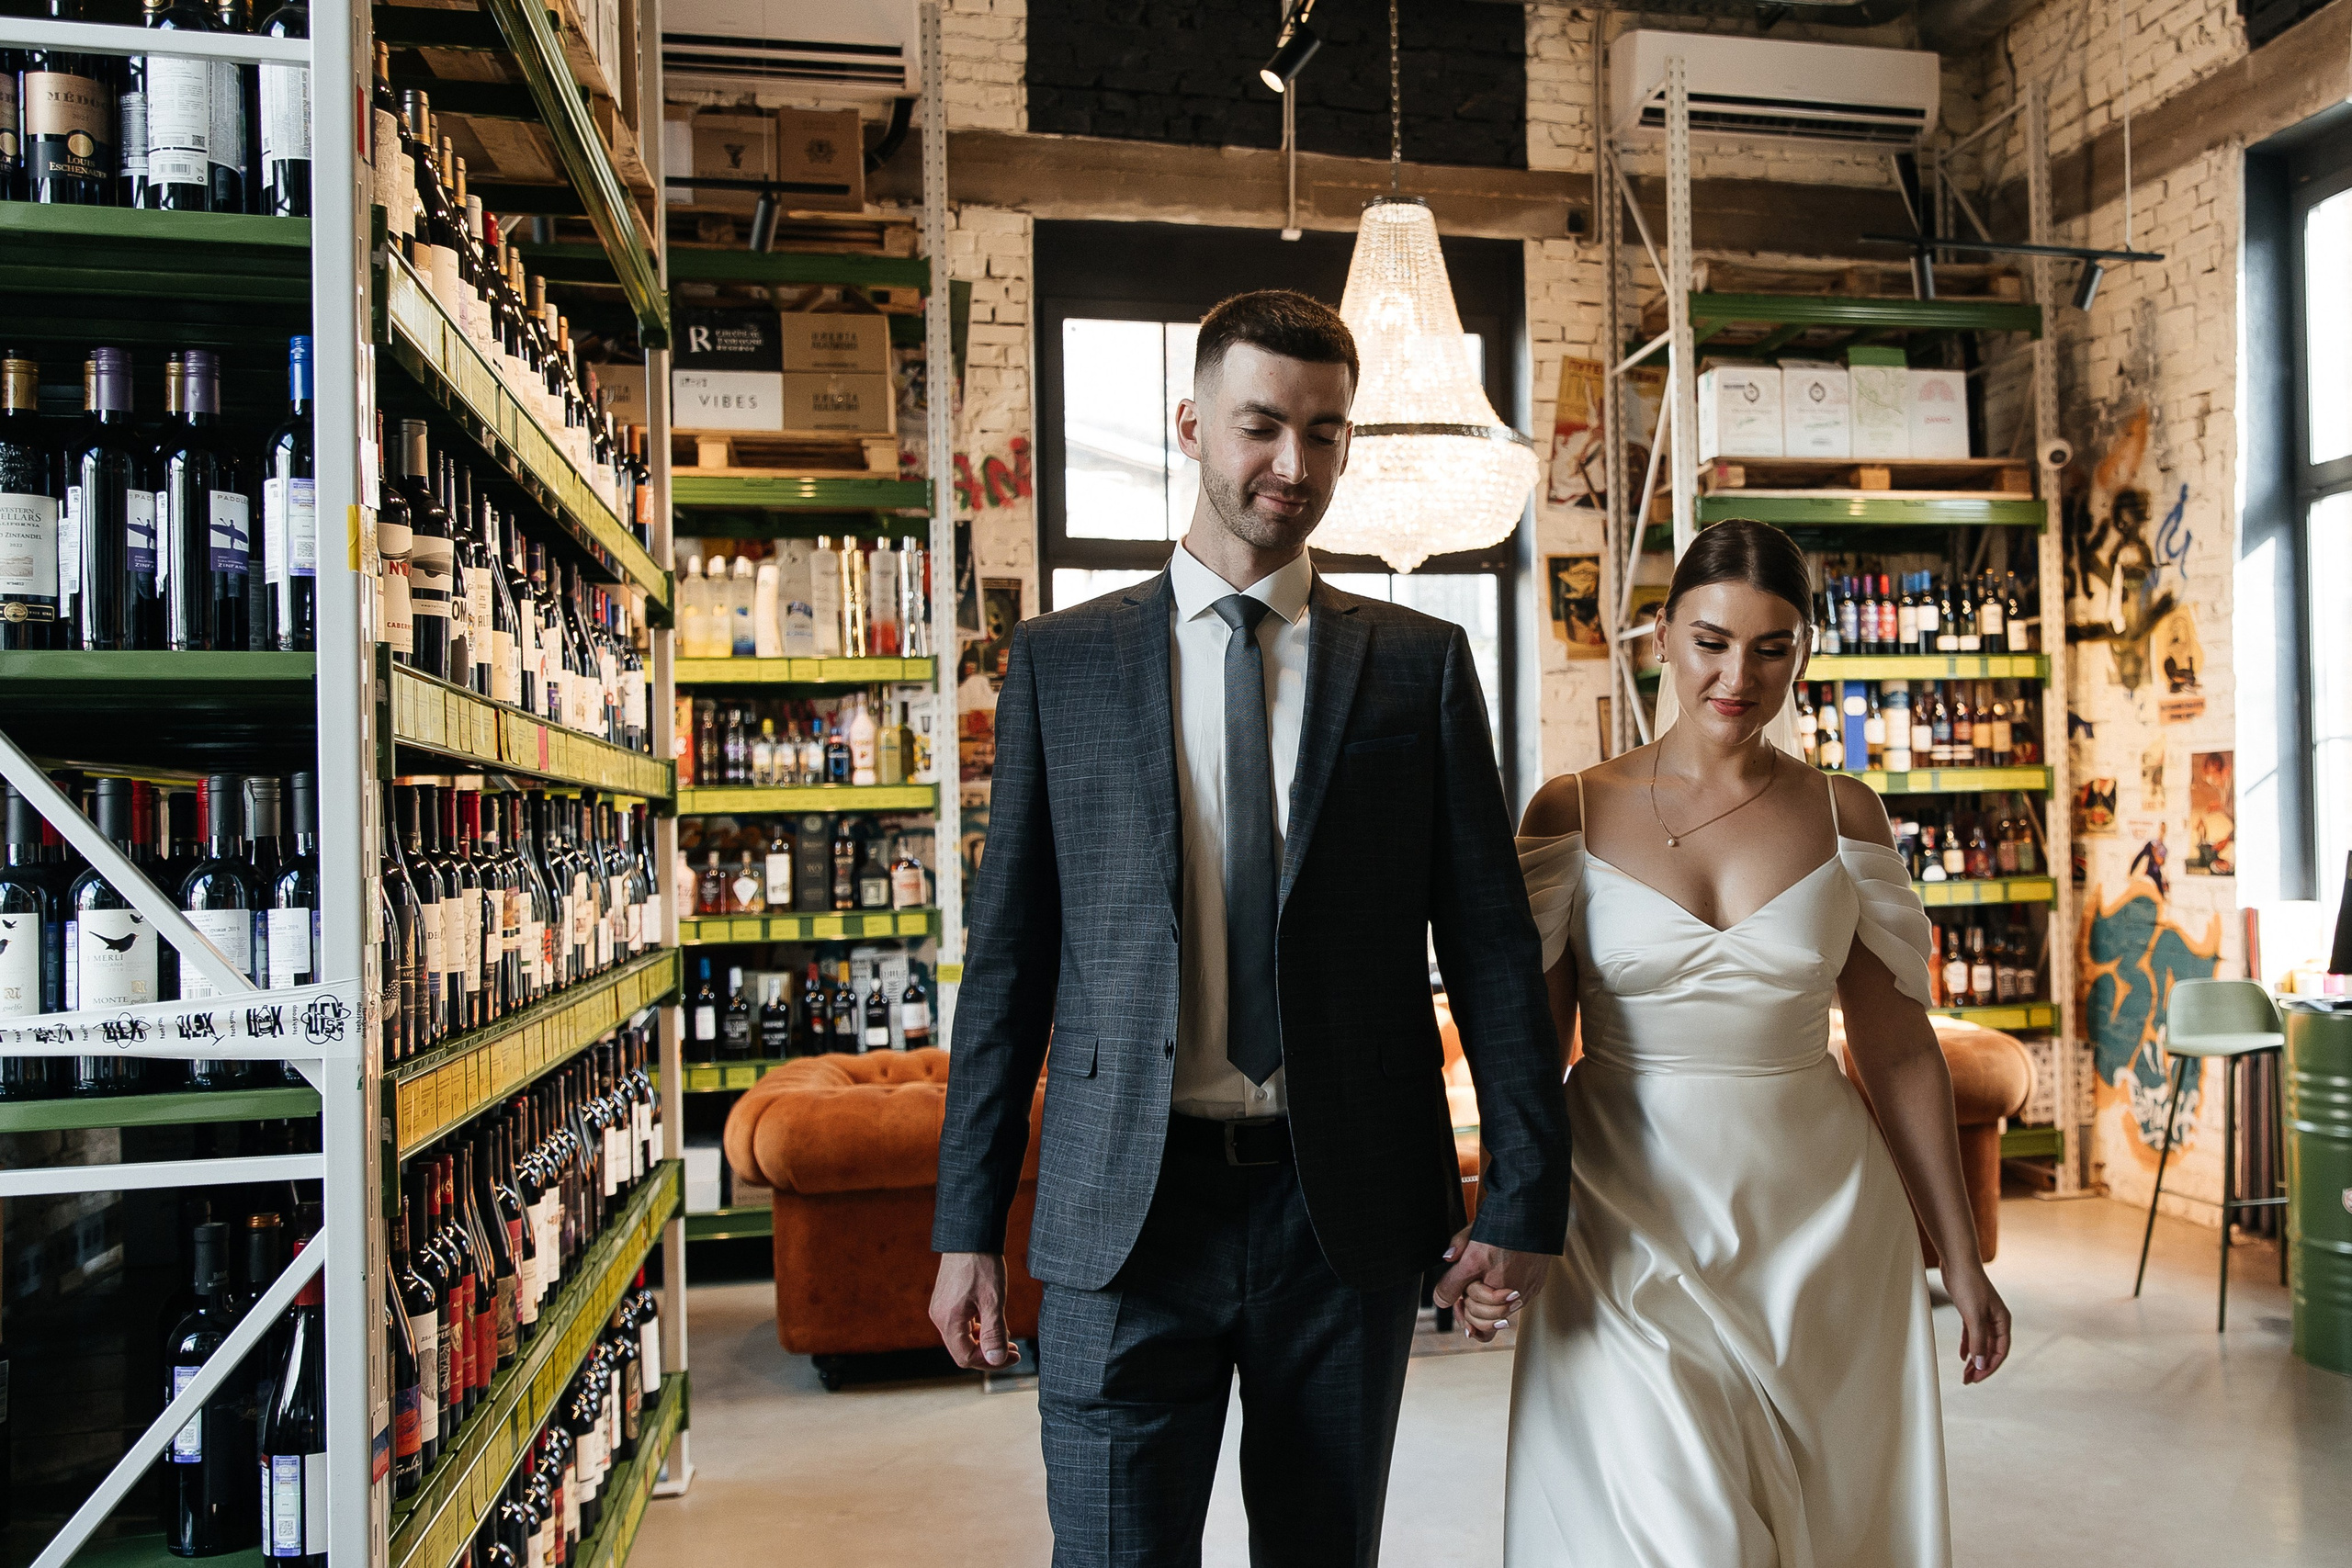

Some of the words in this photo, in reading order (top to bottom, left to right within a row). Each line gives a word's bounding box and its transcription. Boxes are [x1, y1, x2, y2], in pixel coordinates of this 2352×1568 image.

[67, 155, 96, 167] LOUIS
[689, 324, 713, 354] R
[698, 394, 758, 410] VIBES
[1, 513, 41, 522] ELLARS
[94, 953, 124, 962] MERLI
[93, 996, 129, 1005] MONTE
